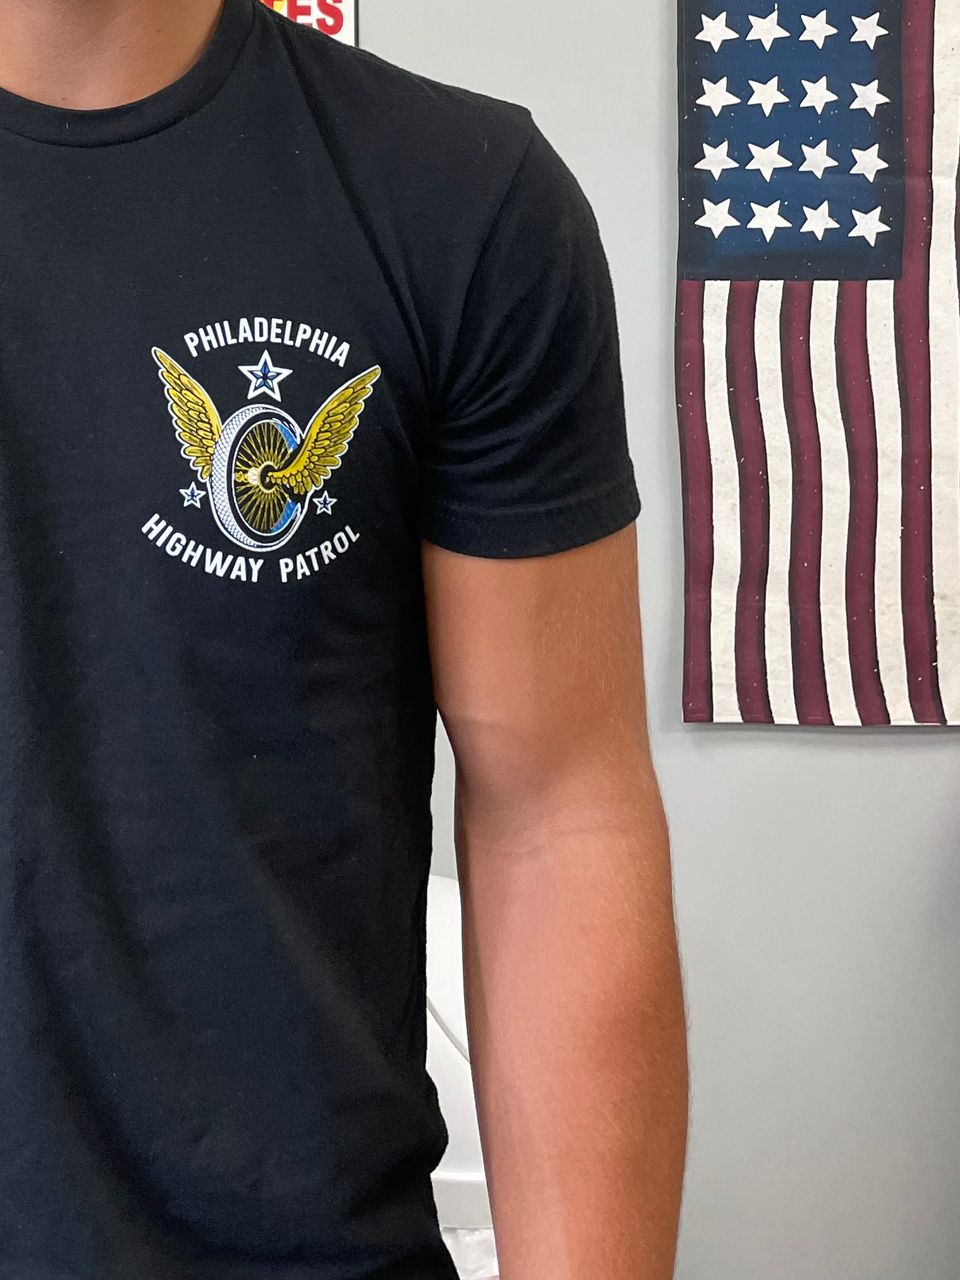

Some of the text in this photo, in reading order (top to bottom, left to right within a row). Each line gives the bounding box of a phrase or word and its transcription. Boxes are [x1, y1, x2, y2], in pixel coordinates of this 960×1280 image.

[183, 317, 350, 368] PHILADELPHIA
[141, 513, 360, 583] HIGHWAY PATROL
